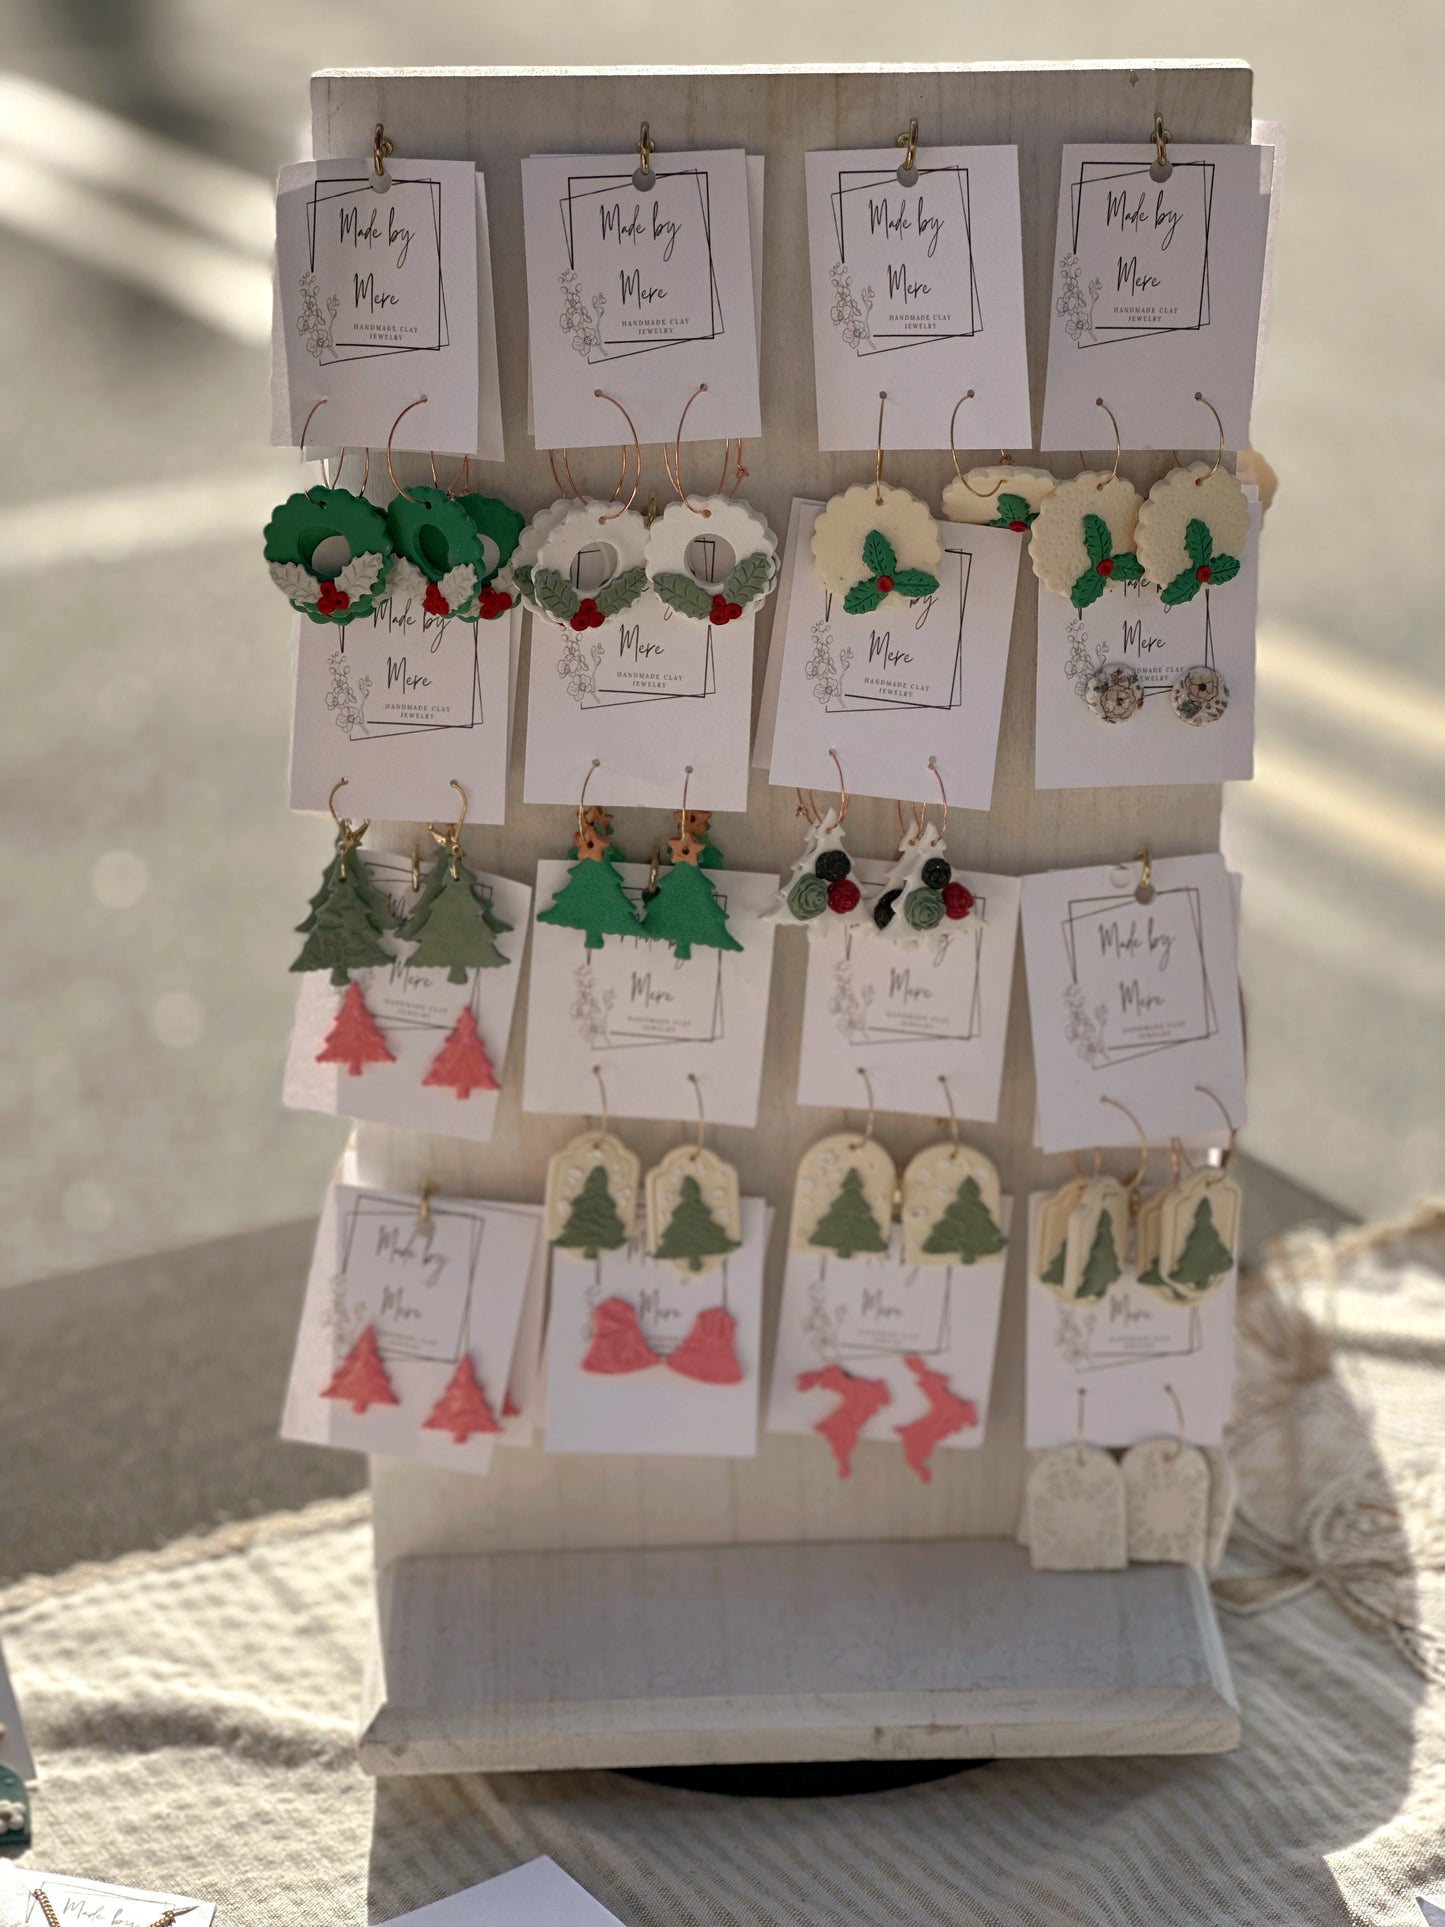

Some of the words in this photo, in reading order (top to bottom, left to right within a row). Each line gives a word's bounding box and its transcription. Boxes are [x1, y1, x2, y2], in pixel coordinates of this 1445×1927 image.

[868, 198, 912, 240] Made
[918, 196, 944, 258] by
[1107, 190, 1149, 233] Made
[1155, 190, 1183, 251] by
[339, 206, 382, 249] Made
[389, 206, 415, 269] by
[599, 203, 646, 245] Made
[653, 201, 682, 262] by
[887, 263, 932, 304] Mere
[1117, 256, 1161, 296] Mere
[353, 272, 399, 314] Mere
[619, 269, 668, 310] Mere
[888, 313, 931, 322] HANDMADE
[932, 313, 952, 321] CLAY
[1113, 306, 1156, 314] HANDMADE
[1158, 306, 1179, 315] CLAY
[621, 317, 667, 328] HANDMADE
[668, 317, 690, 326] CLAY
[904, 321, 937, 330] JEWELRY
[1127, 315, 1163, 323] JEWELRY
[353, 322, 397, 333] HANDMADE
[399, 325, 419, 334] CLAY
[637, 327, 674, 336] JEWELRY
[368, 332, 404, 342] JEWELRY
[373, 596, 416, 635] Made
[619, 624, 664, 663] Mere
[1122, 619, 1166, 658] Mere
[869, 629, 914, 670] Mere
[386, 656, 432, 695] Mere
[616, 671, 661, 680] HANDMADE
[663, 674, 684, 682] CLAY
[631, 680, 667, 689] JEWELRY
[863, 677, 909, 688] HANDMADE
[909, 683, 931, 692] CLAY
[878, 687, 915, 698] JEWELRY
[384, 703, 429, 712] HANDMADE
[430, 704, 451, 713] CLAY
[399, 711, 435, 720] JEWELRY
